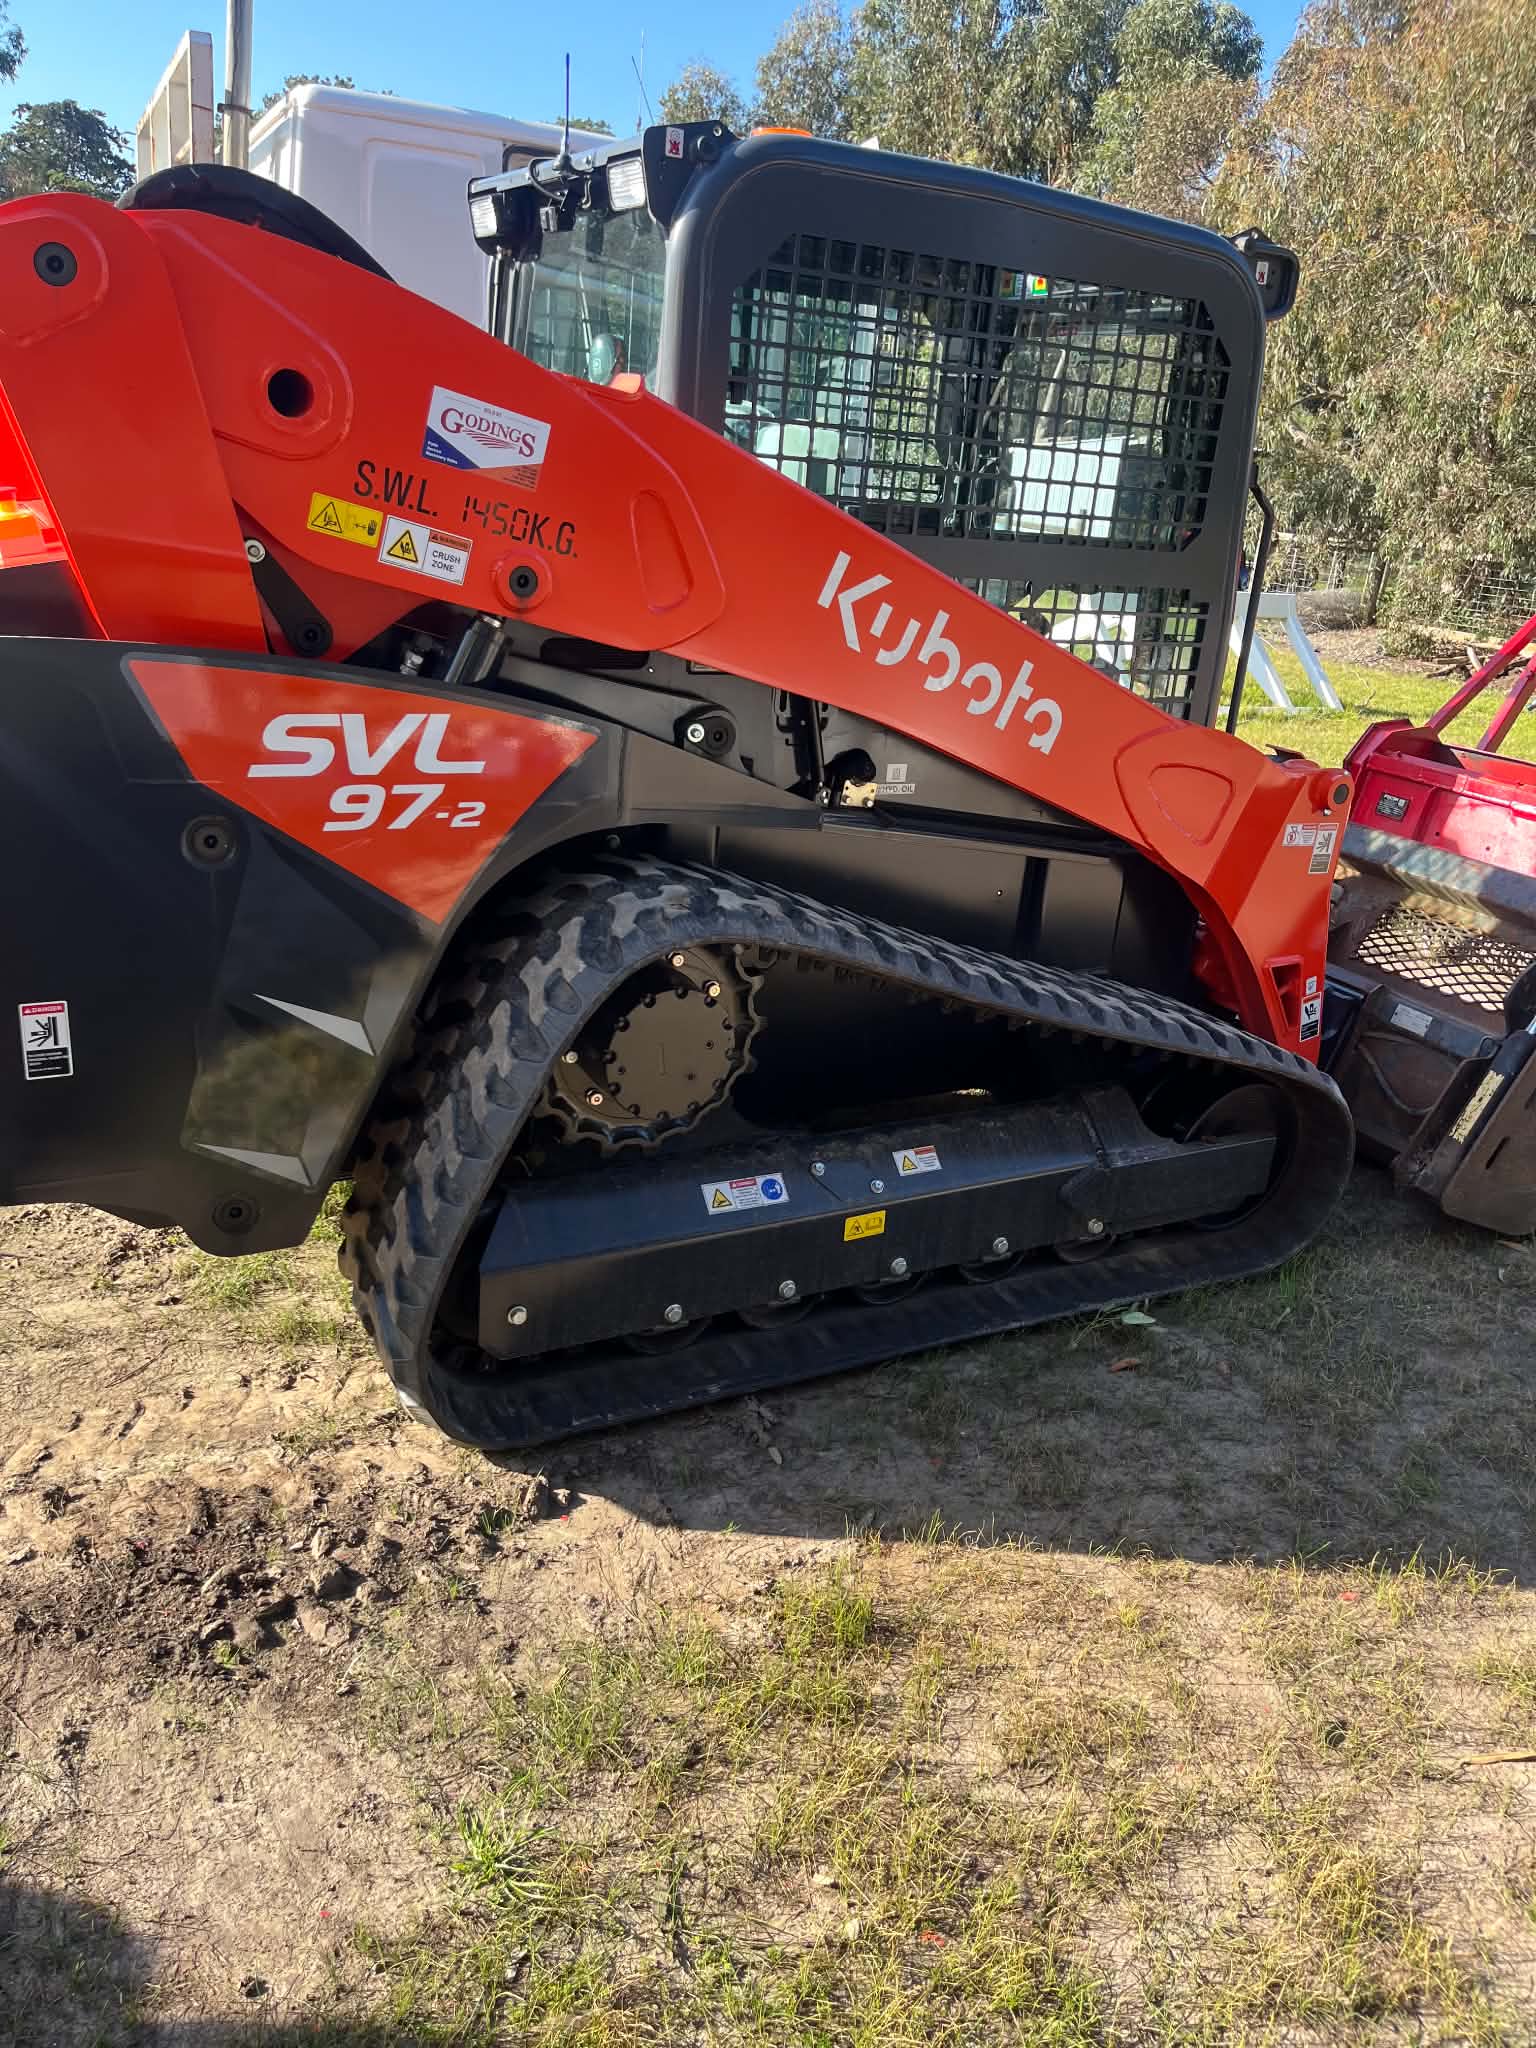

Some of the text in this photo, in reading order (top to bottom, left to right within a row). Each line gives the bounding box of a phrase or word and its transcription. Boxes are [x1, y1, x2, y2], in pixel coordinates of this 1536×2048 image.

[440, 407, 536, 458] GODINGS
[353, 460, 438, 517] S.W.L.
[432, 550, 461, 564] CRUSH
[817, 550, 1063, 755] Kubota
[247, 713, 487, 778] SVL
[322, 783, 487, 832] 97-2
